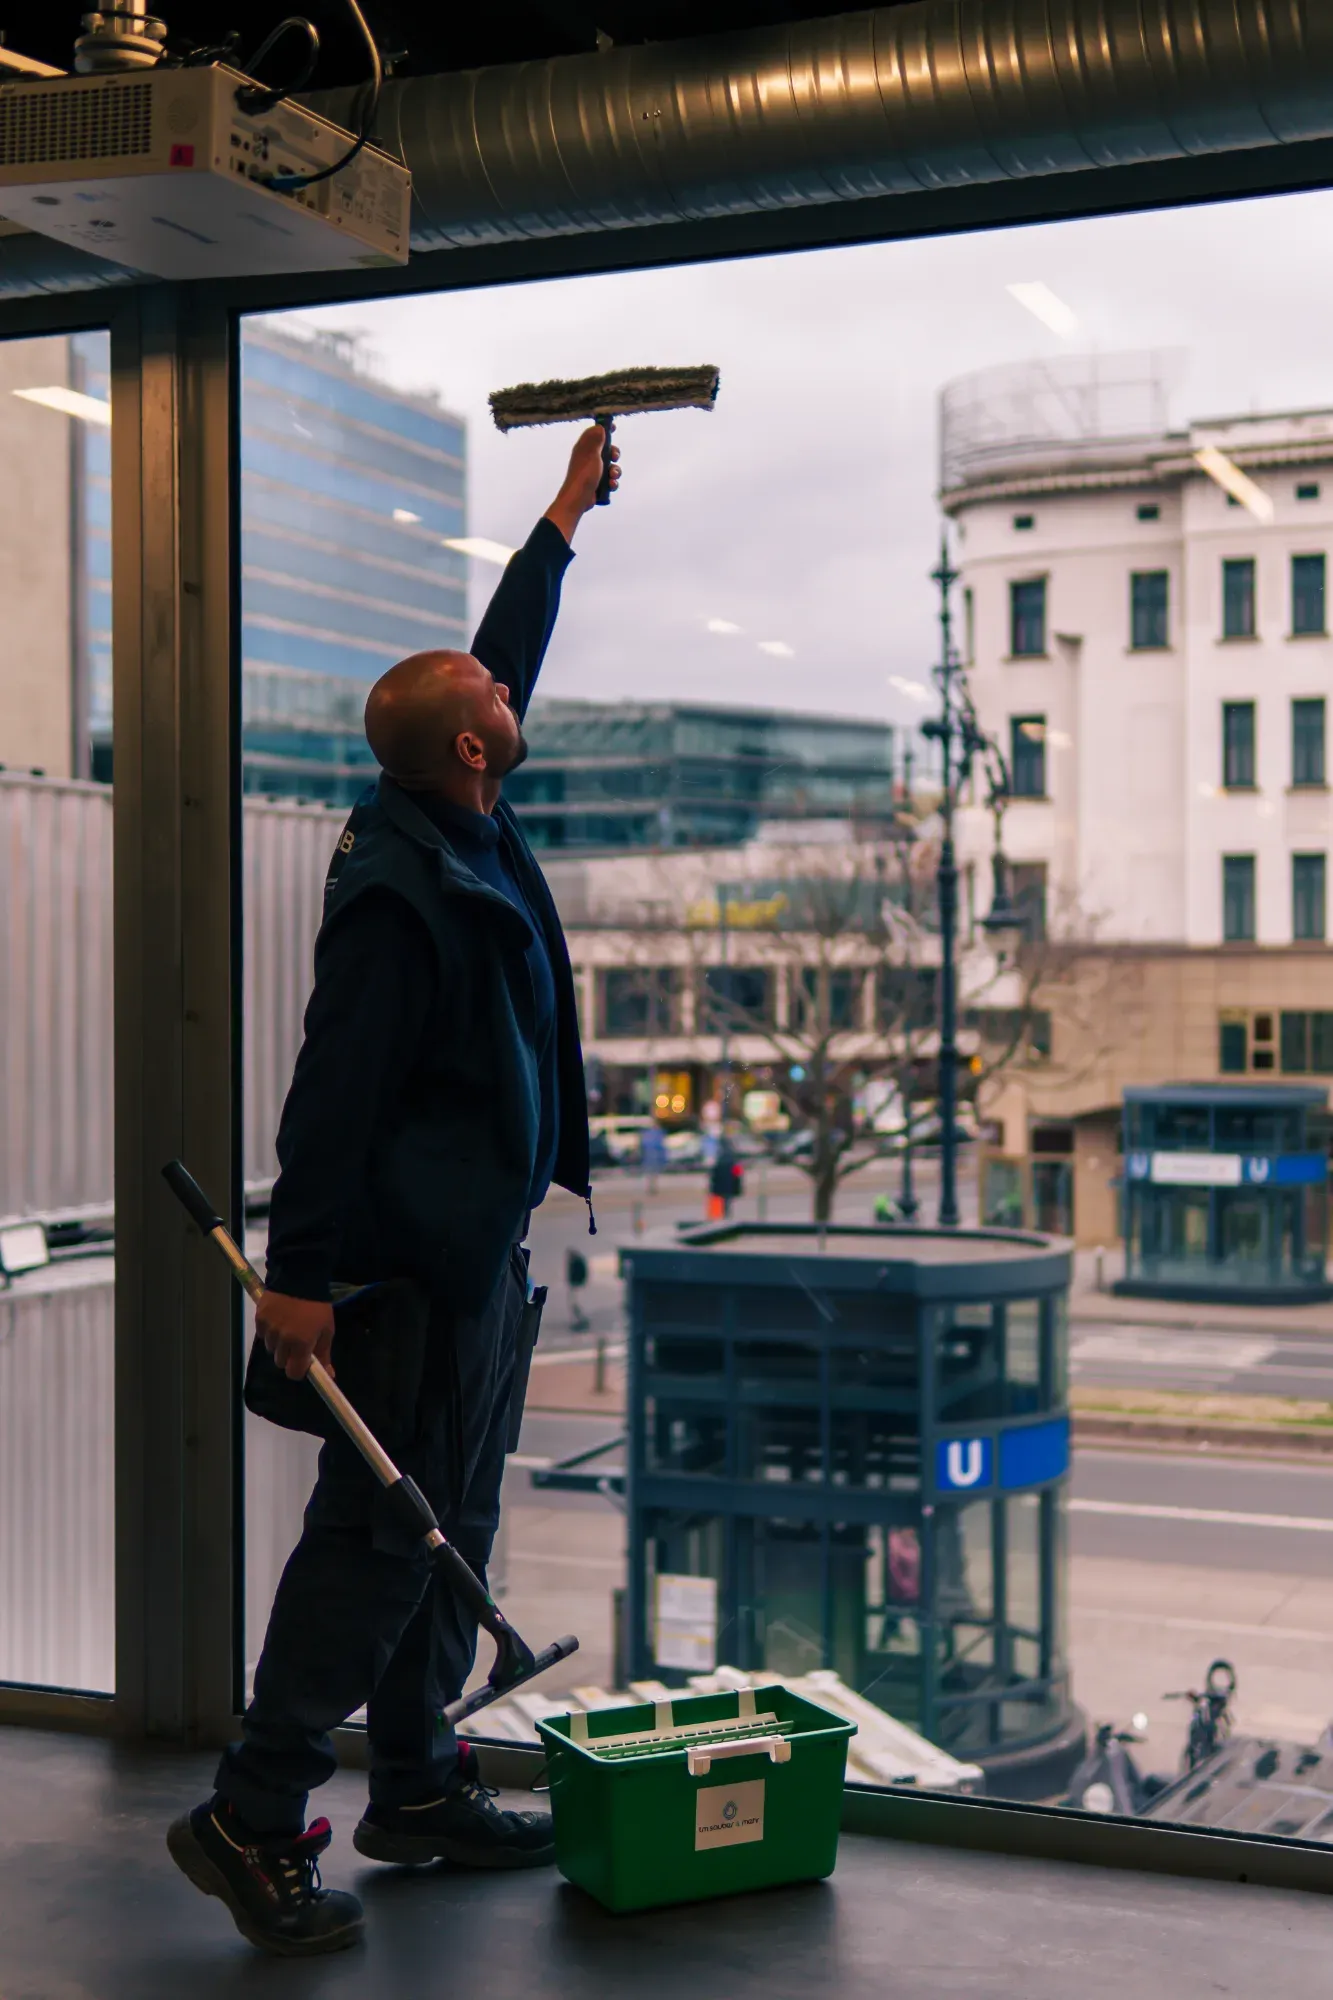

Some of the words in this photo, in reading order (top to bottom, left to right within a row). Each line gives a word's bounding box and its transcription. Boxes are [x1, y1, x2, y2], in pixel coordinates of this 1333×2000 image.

[337, 829, 355, 854] B
[1249, 1156, 1270, 1183] U
[947, 1439, 982, 1487] U
